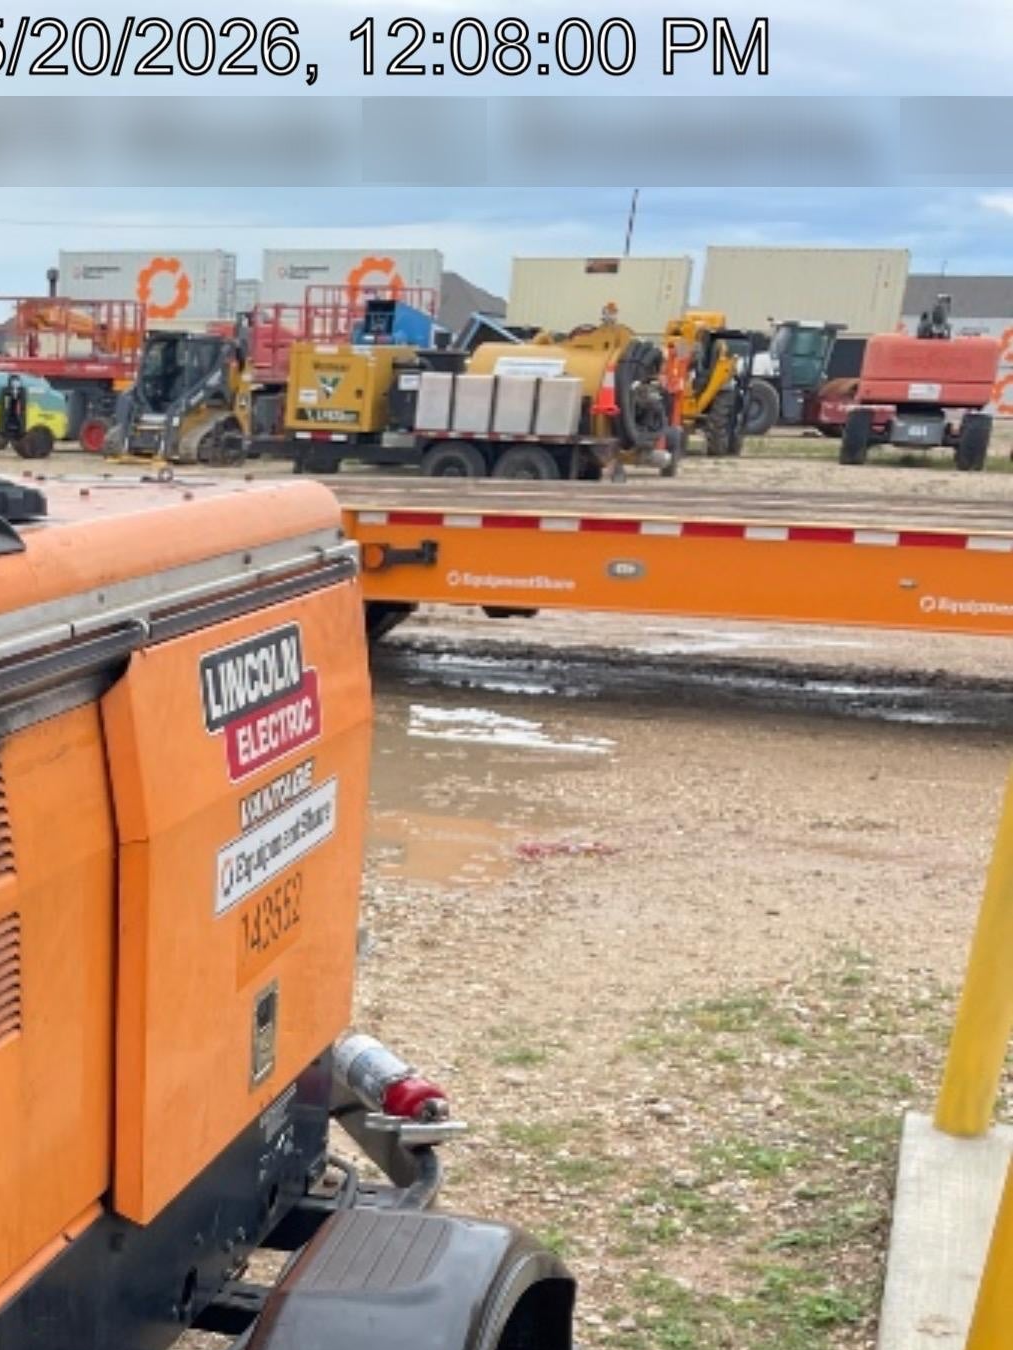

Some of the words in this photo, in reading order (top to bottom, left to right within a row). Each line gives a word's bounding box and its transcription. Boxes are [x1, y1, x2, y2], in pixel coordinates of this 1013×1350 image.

[205, 636, 301, 720] LINCOLN
[237, 697, 313, 767] ELECTRIC
[236, 801, 331, 884] EquipmentShare
